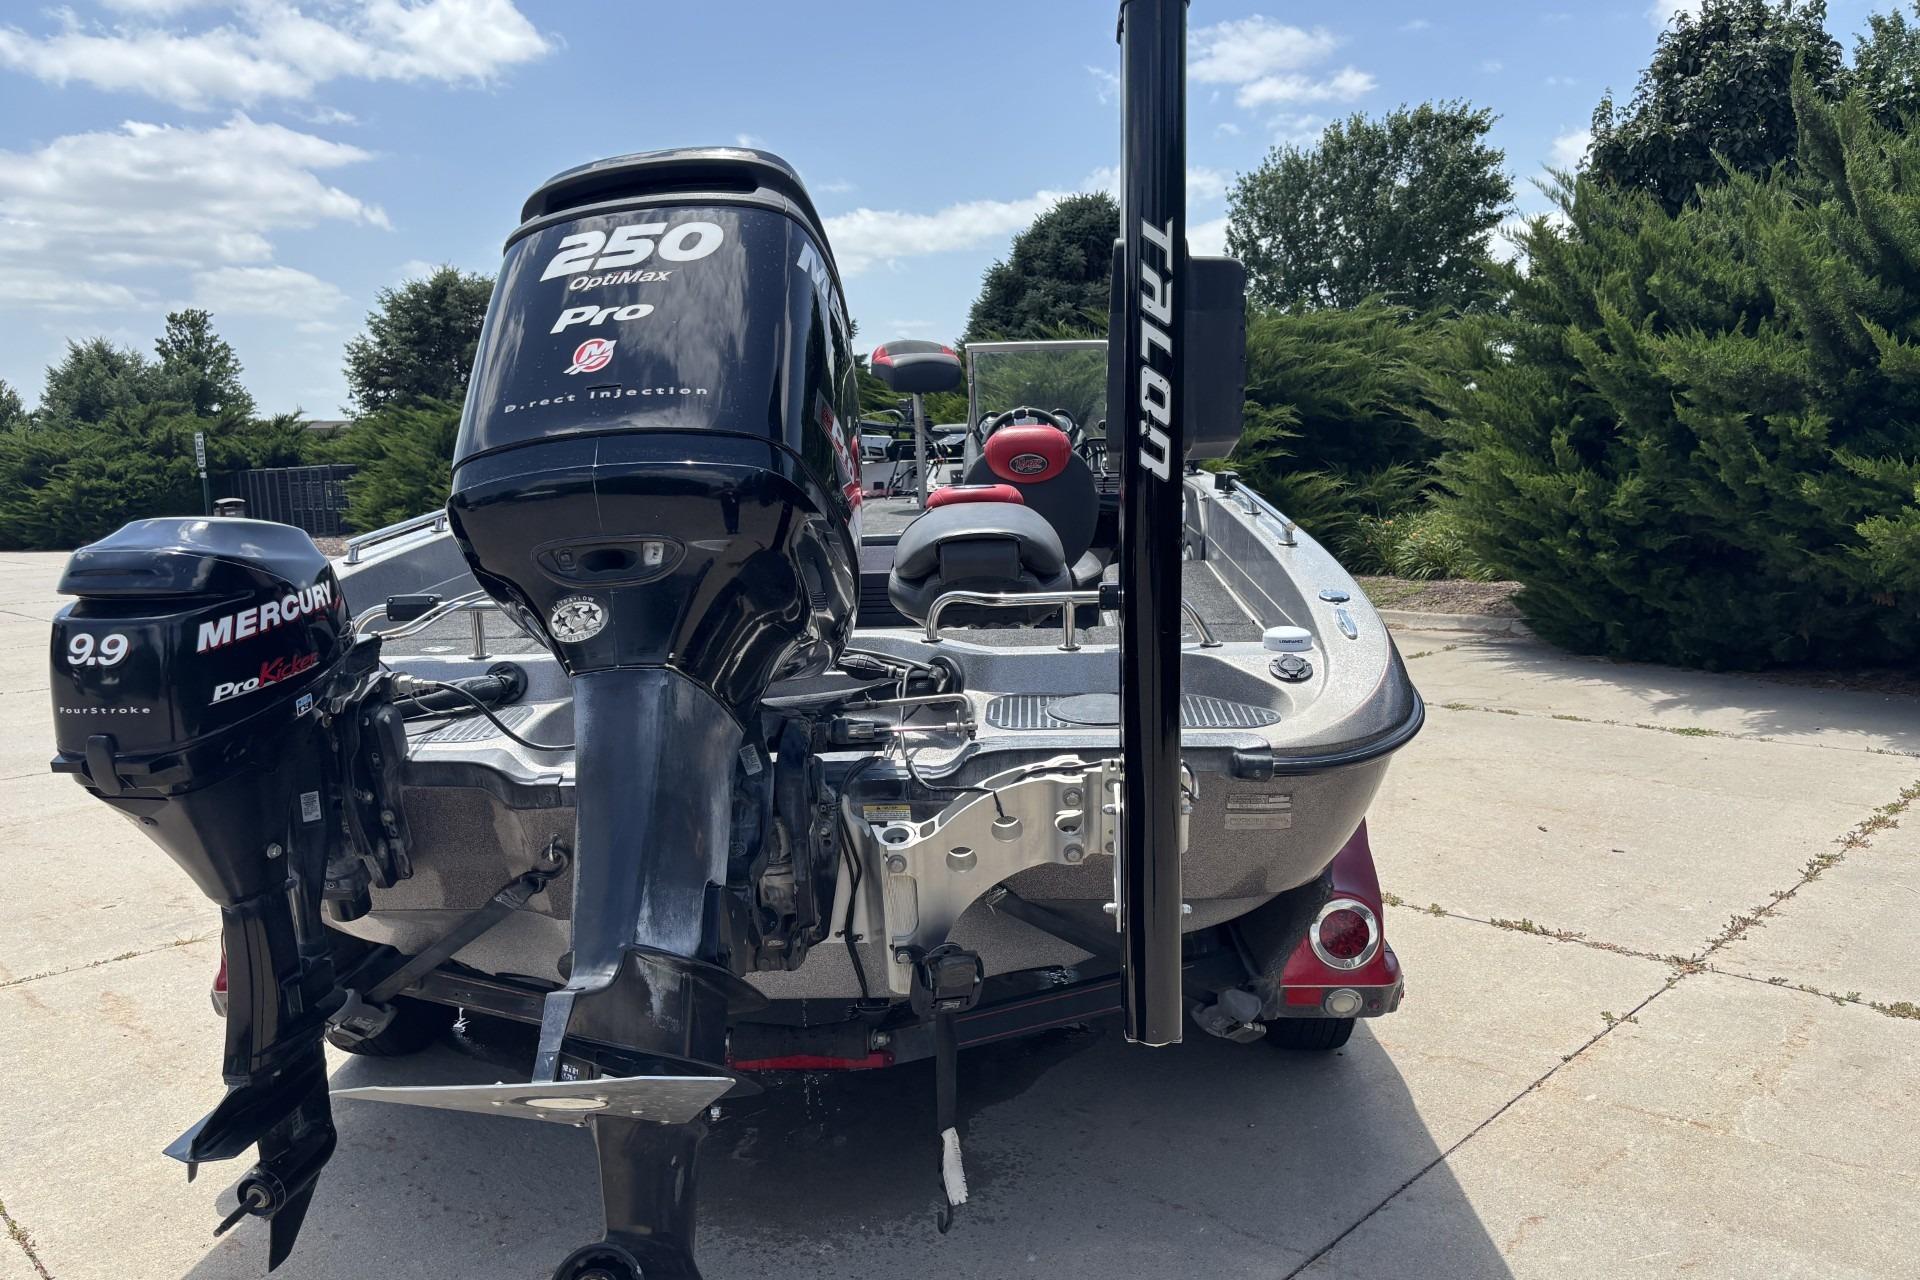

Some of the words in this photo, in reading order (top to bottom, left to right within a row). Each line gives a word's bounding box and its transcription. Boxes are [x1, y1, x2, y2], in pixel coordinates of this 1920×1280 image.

[540, 221, 724, 282] 250
[568, 270, 673, 292] OptiMax
[550, 303, 655, 334] Pro
[589, 386, 708, 400] Injection
[196, 579, 333, 654] MERCURY
[67, 633, 129, 666] 9.9
[212, 651, 320, 702] ProKicker
[59, 706, 151, 714] FourStroke
